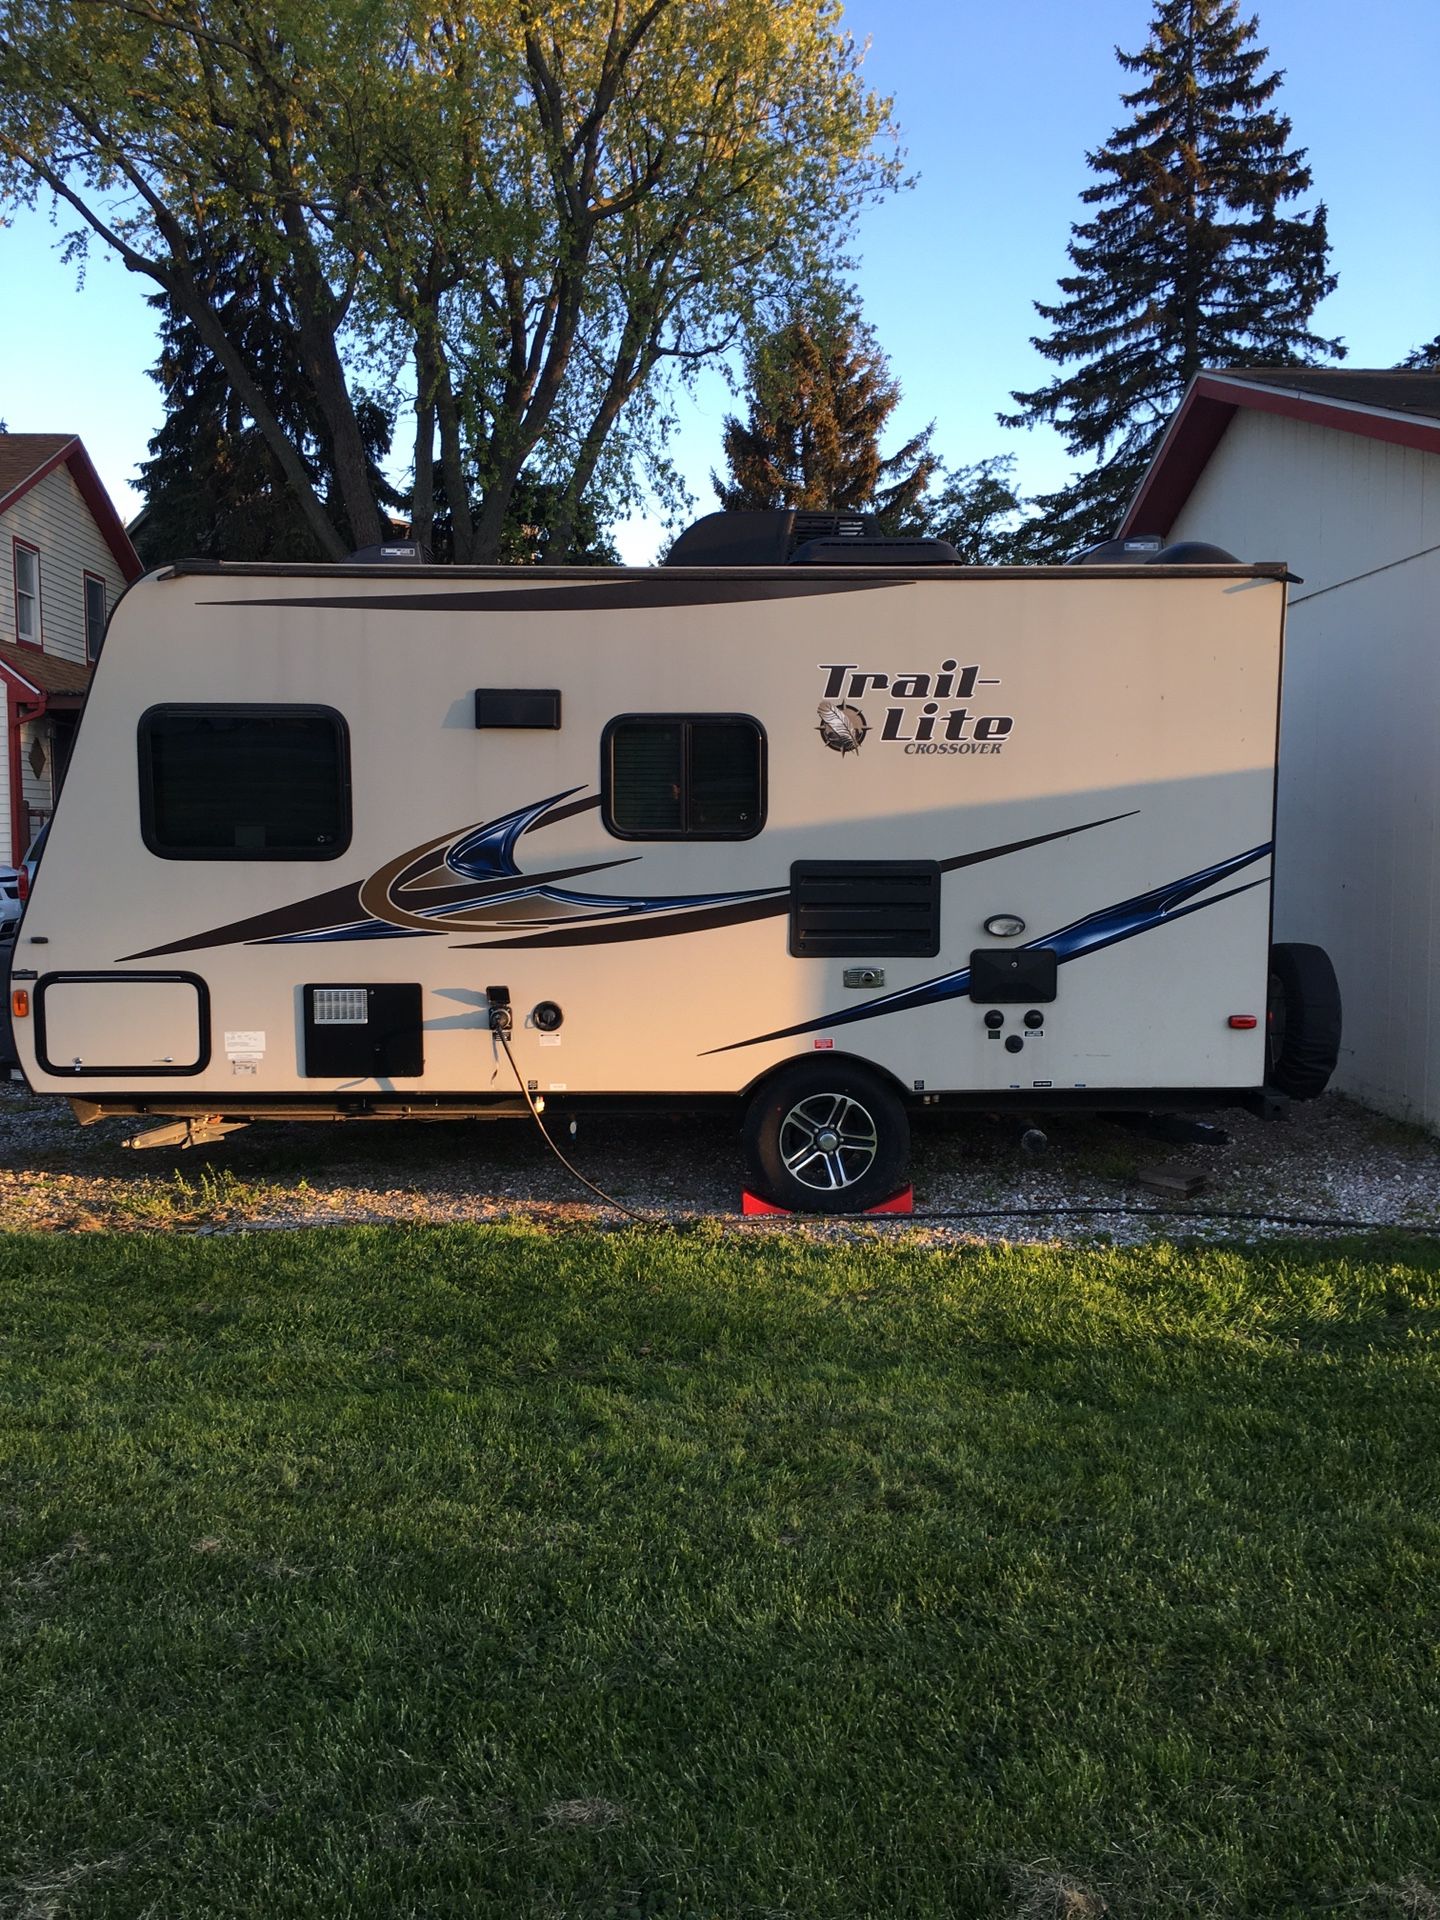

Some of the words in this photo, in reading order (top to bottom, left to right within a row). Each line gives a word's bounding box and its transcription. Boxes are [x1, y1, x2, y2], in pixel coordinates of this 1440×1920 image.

[818, 659, 1001, 699] Trail-
[880, 702, 1014, 742] Lite
[904, 743, 1002, 755] CROSSOVER
